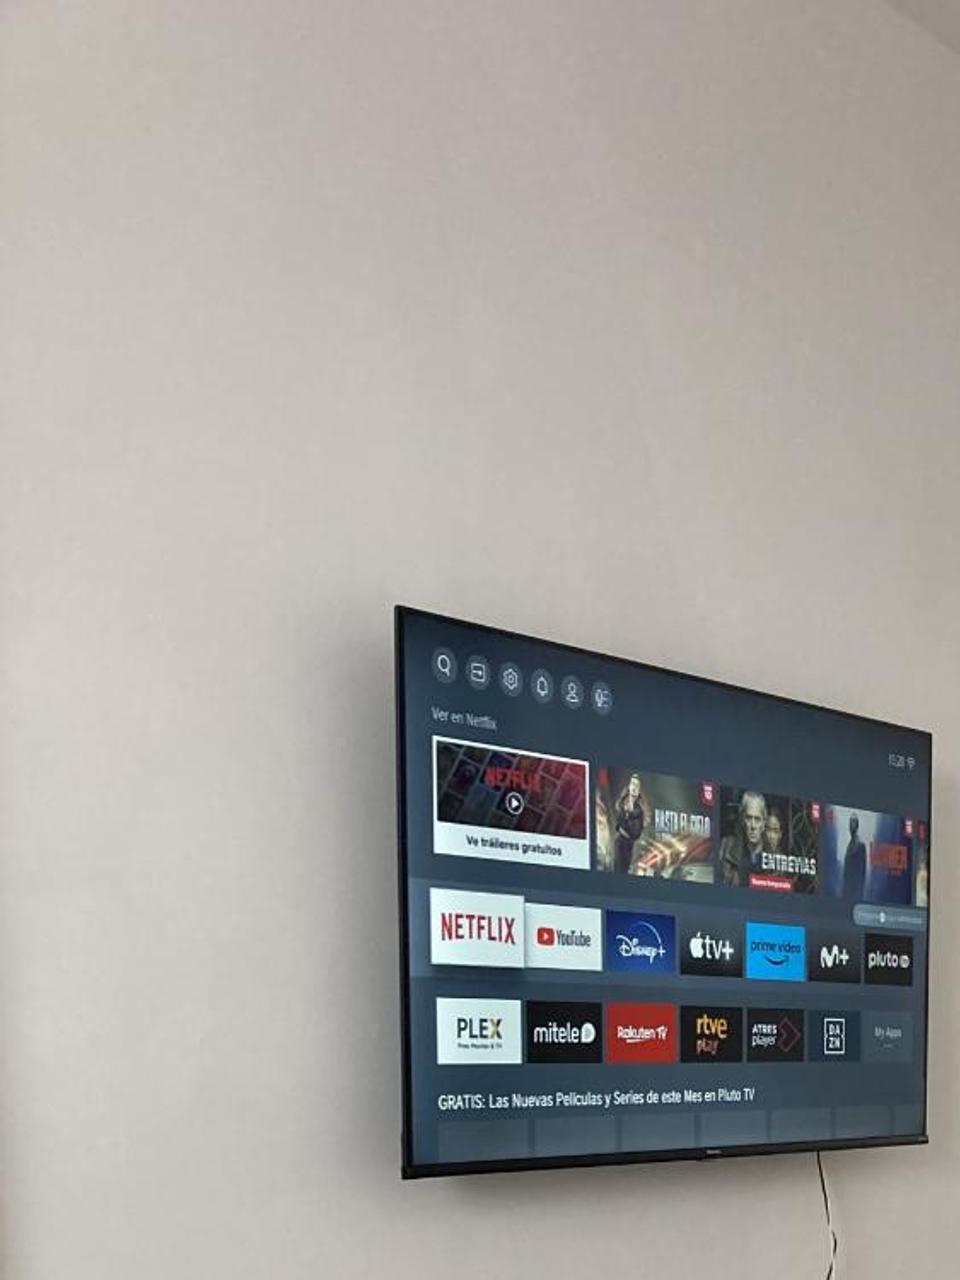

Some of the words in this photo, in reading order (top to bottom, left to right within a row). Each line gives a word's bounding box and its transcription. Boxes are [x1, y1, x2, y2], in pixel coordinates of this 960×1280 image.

[431, 706, 449, 721] Ver
[451, 712, 464, 724] en
[466, 712, 498, 730] Netflix
[465, 834, 479, 847] Ve
[521, 843, 562, 856] gratuitos
[441, 912, 516, 945] NETFLIX
[556, 929, 592, 947] YouTube
[750, 940, 778, 952] prime
[779, 941, 801, 953] video
[616, 934, 667, 964] Disney+
[868, 951, 899, 969] pluto
[457, 1018, 502, 1040] PLEX
[617, 1025, 656, 1042] Rakuten
[697, 1014, 728, 1039] rtve
[752, 1024, 777, 1035] ATRES
[874, 1026, 885, 1039] My
[697, 1038, 719, 1055] play
[751, 1035, 777, 1048] player
[438, 1094, 486, 1110] GRATIS:
[488, 1093, 509, 1109] Las
[511, 1092, 554, 1108] Nuevas
[604, 1093, 612, 1109] y
[613, 1089, 644, 1105] Series
[646, 1089, 660, 1104] de
[661, 1089, 682, 1104] este
[683, 1088, 703, 1103] Mes
[704, 1090, 716, 1102] en
[717, 1088, 742, 1102] Pluto
[743, 1087, 756, 1101] TV
